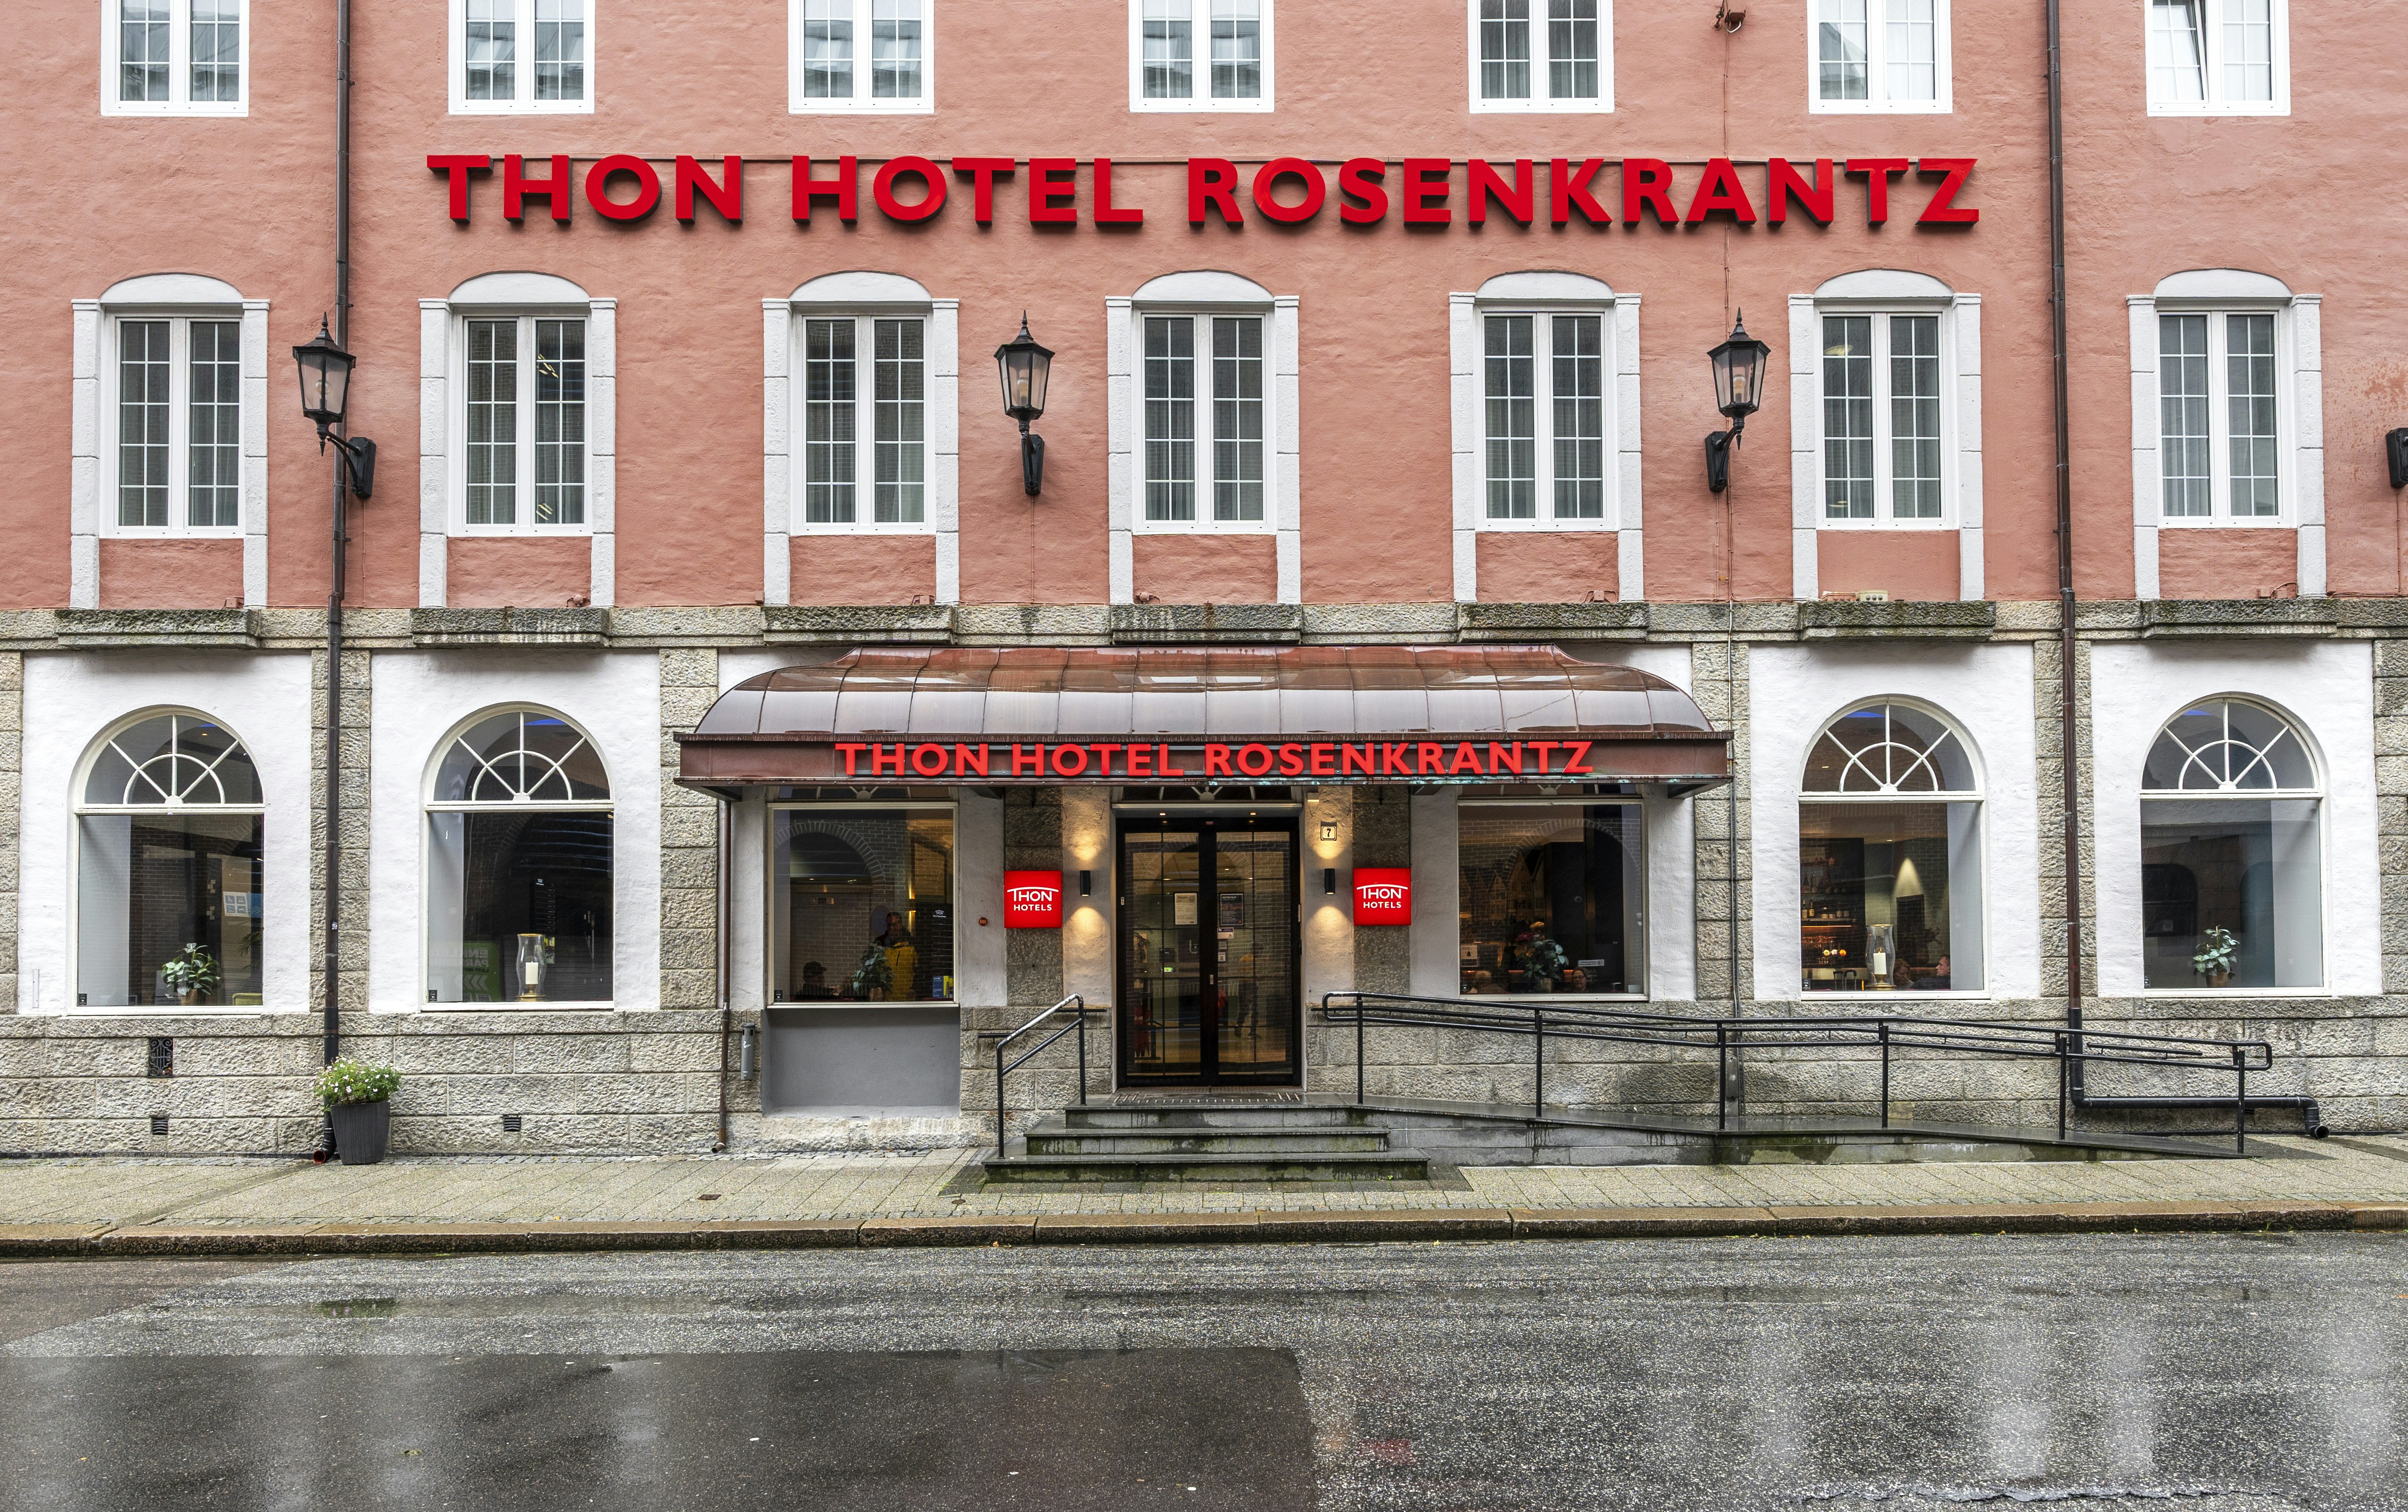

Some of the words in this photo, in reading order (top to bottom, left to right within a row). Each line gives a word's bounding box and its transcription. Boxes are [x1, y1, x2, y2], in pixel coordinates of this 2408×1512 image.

[427, 155, 742, 221] THON
[792, 156, 1144, 223] HOTEL
[1188, 158, 1979, 224] ROSENKRANTZ
[835, 743, 988, 776] THON
[1012, 744, 1184, 776] HOTEL
[1205, 741, 1593, 776] ROSENKRANTZ
[1327, 828, 1331, 837] 7
[1007, 886, 1059, 902] THON
[1356, 884, 1408, 899] THON
